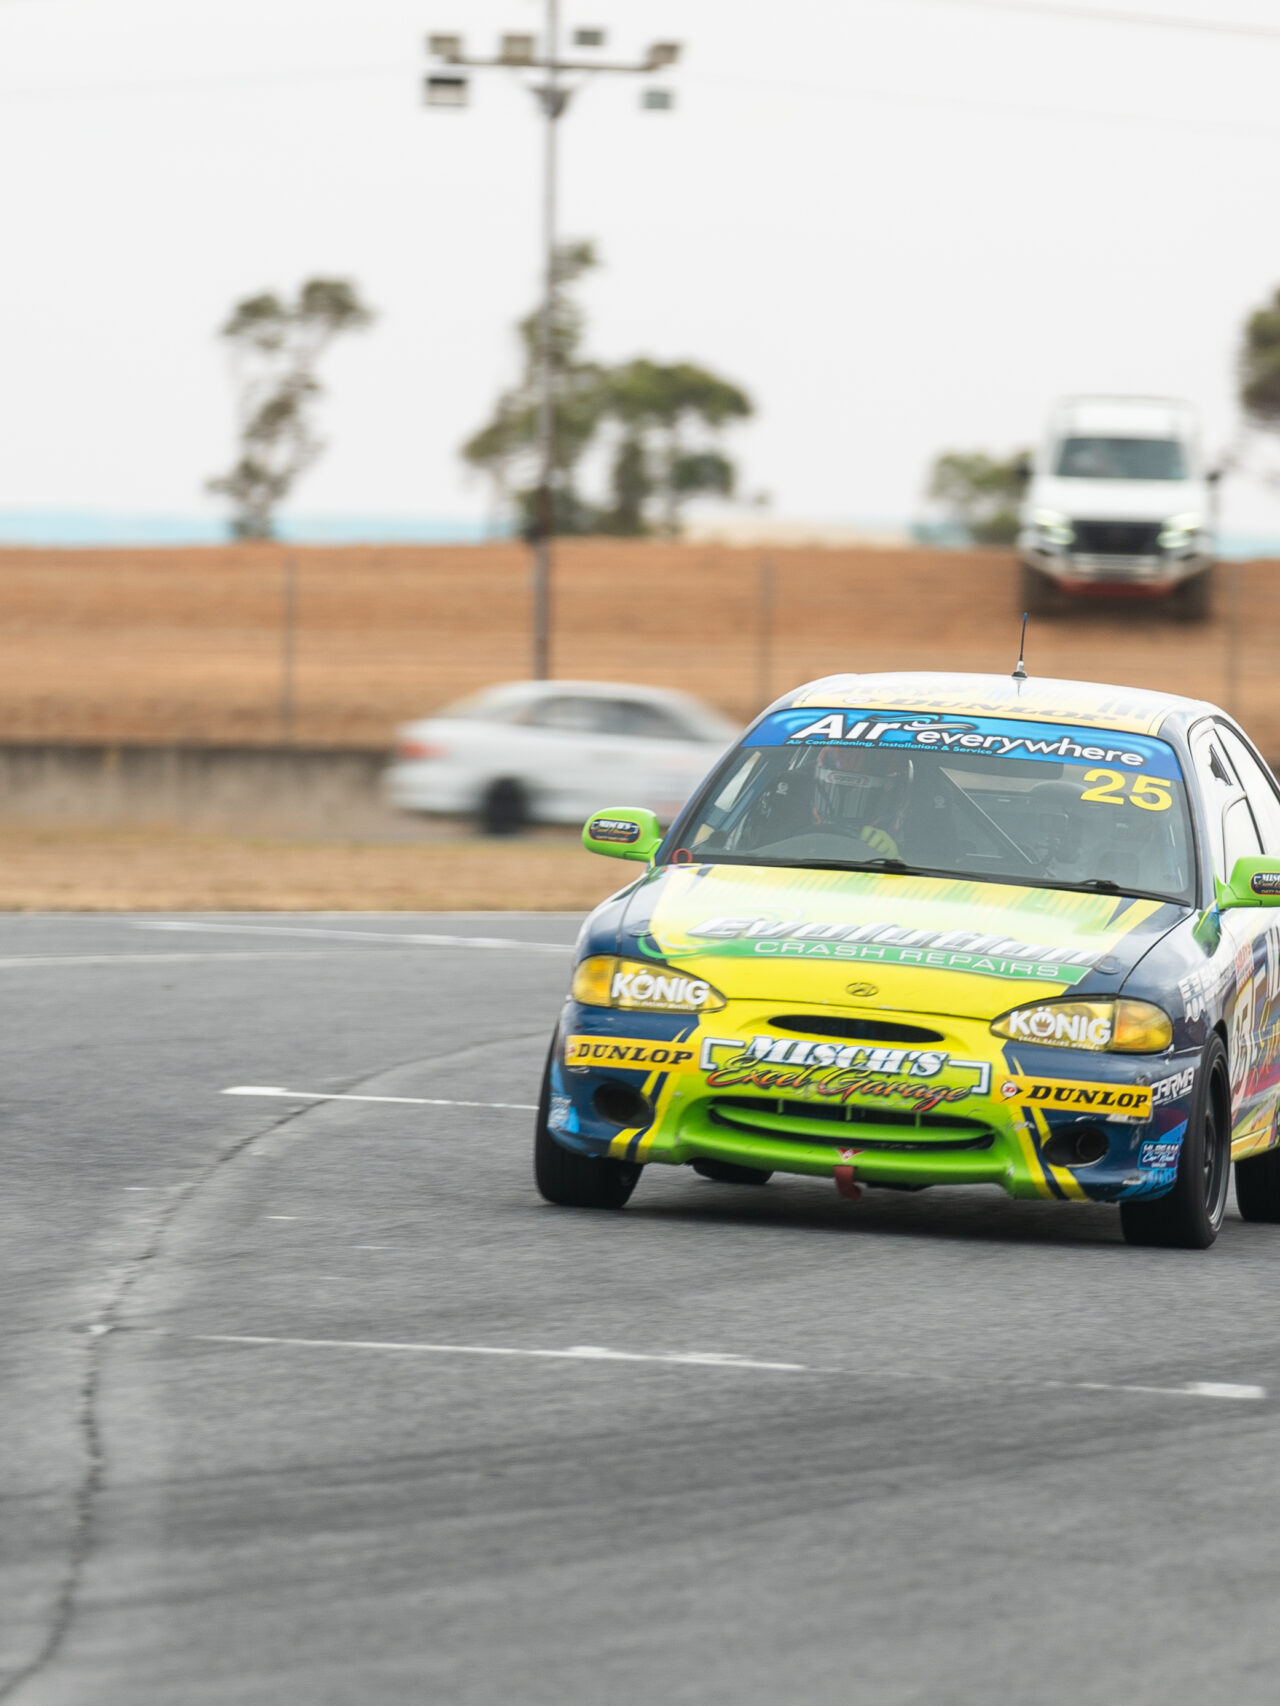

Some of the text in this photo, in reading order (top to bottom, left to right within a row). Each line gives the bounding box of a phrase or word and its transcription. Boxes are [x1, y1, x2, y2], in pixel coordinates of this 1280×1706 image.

[791, 714, 1146, 767] Air everywhere
[878, 742, 938, 750] Installation
[953, 746, 993, 755] Service
[1080, 768, 1173, 812] 25
[686, 916, 1098, 967] Evolution
[753, 940, 1060, 978] CRASH REPAIRS
[611, 969, 710, 1005] KÖNIG
[1009, 1006, 1112, 1045] KÖNIG
[577, 1043, 693, 1065] DUNLOP
[744, 1036, 948, 1077] MISCH'S
[707, 1054, 972, 1112] Excel Garage
[1026, 1084, 1149, 1109] DUNLOP
